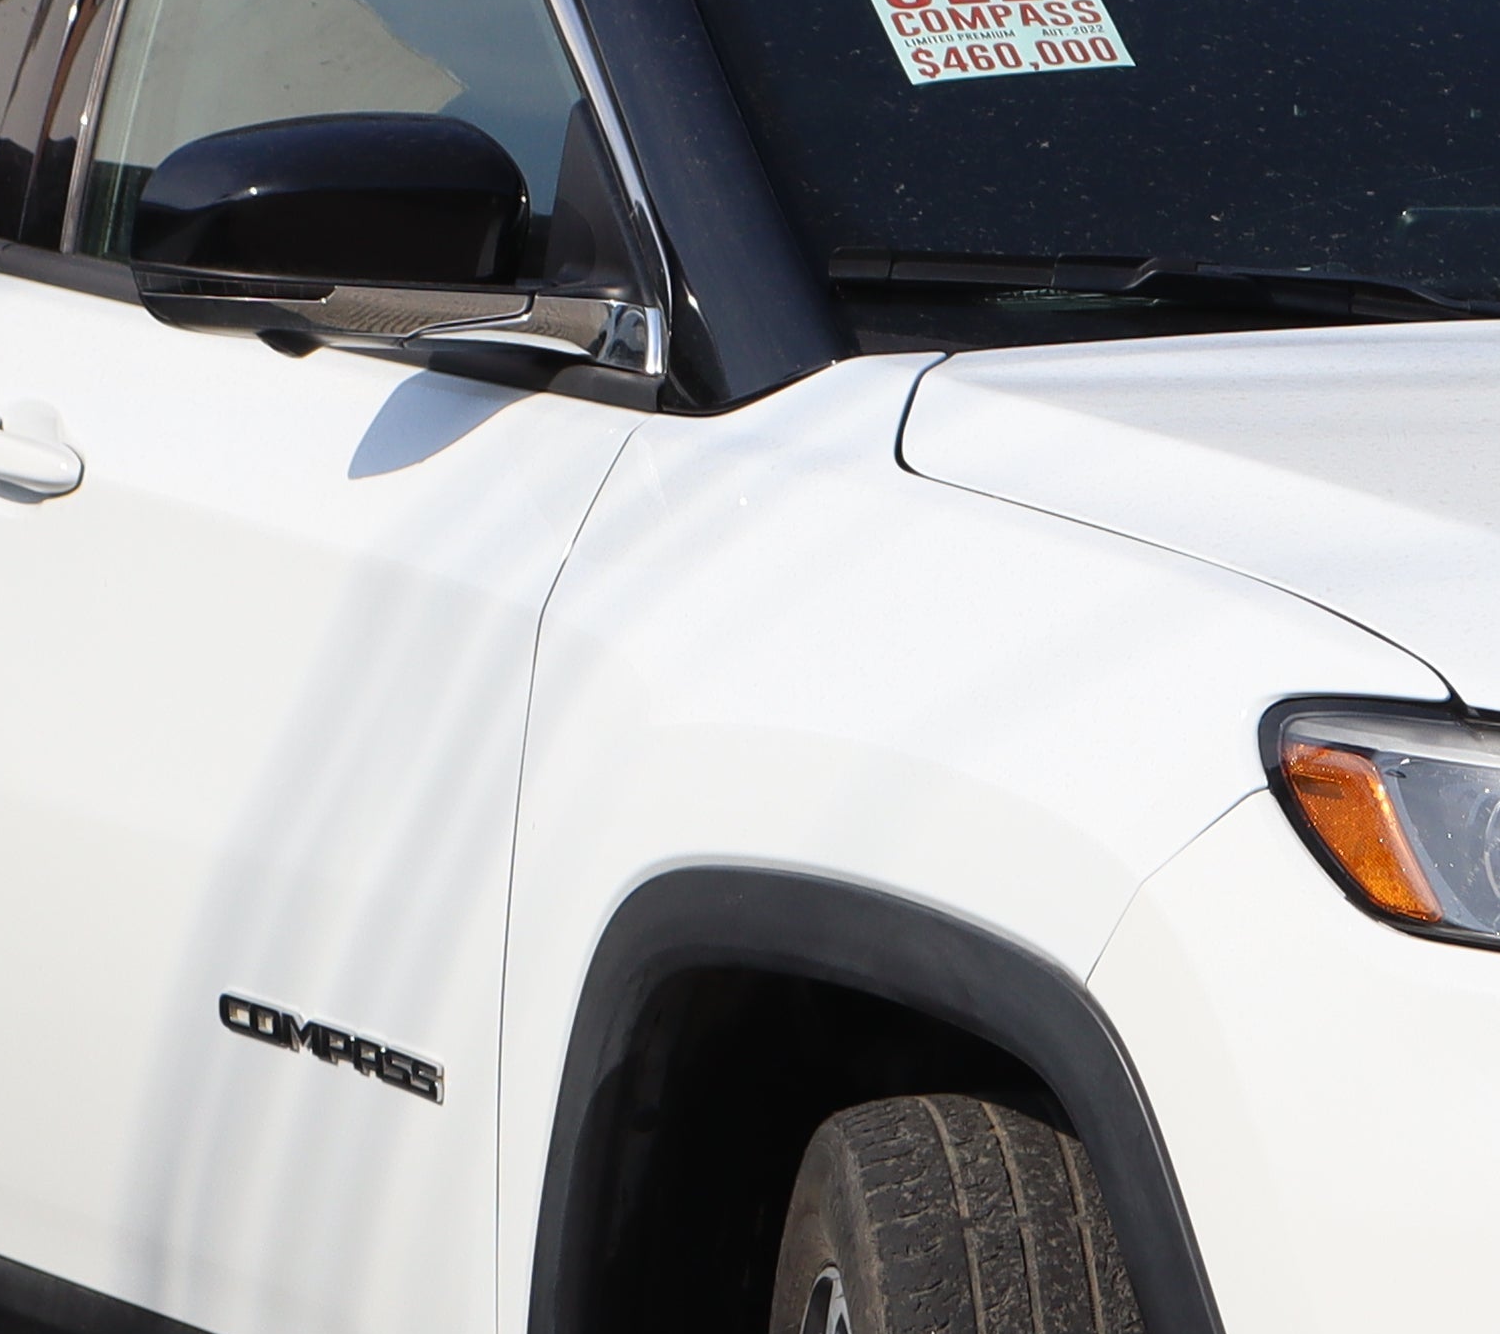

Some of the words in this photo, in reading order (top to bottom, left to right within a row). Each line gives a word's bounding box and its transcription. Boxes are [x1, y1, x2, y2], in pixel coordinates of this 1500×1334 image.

[891, 0, 1102, 37] COMPASS
[904, 31, 954, 47] LIMITED
[958, 29, 1016, 41] PREMIUM
[1073, 25, 1105, 35] 2022
[912, 37, 1118, 79] $460,000
[219, 992, 445, 1106] COMPASS
